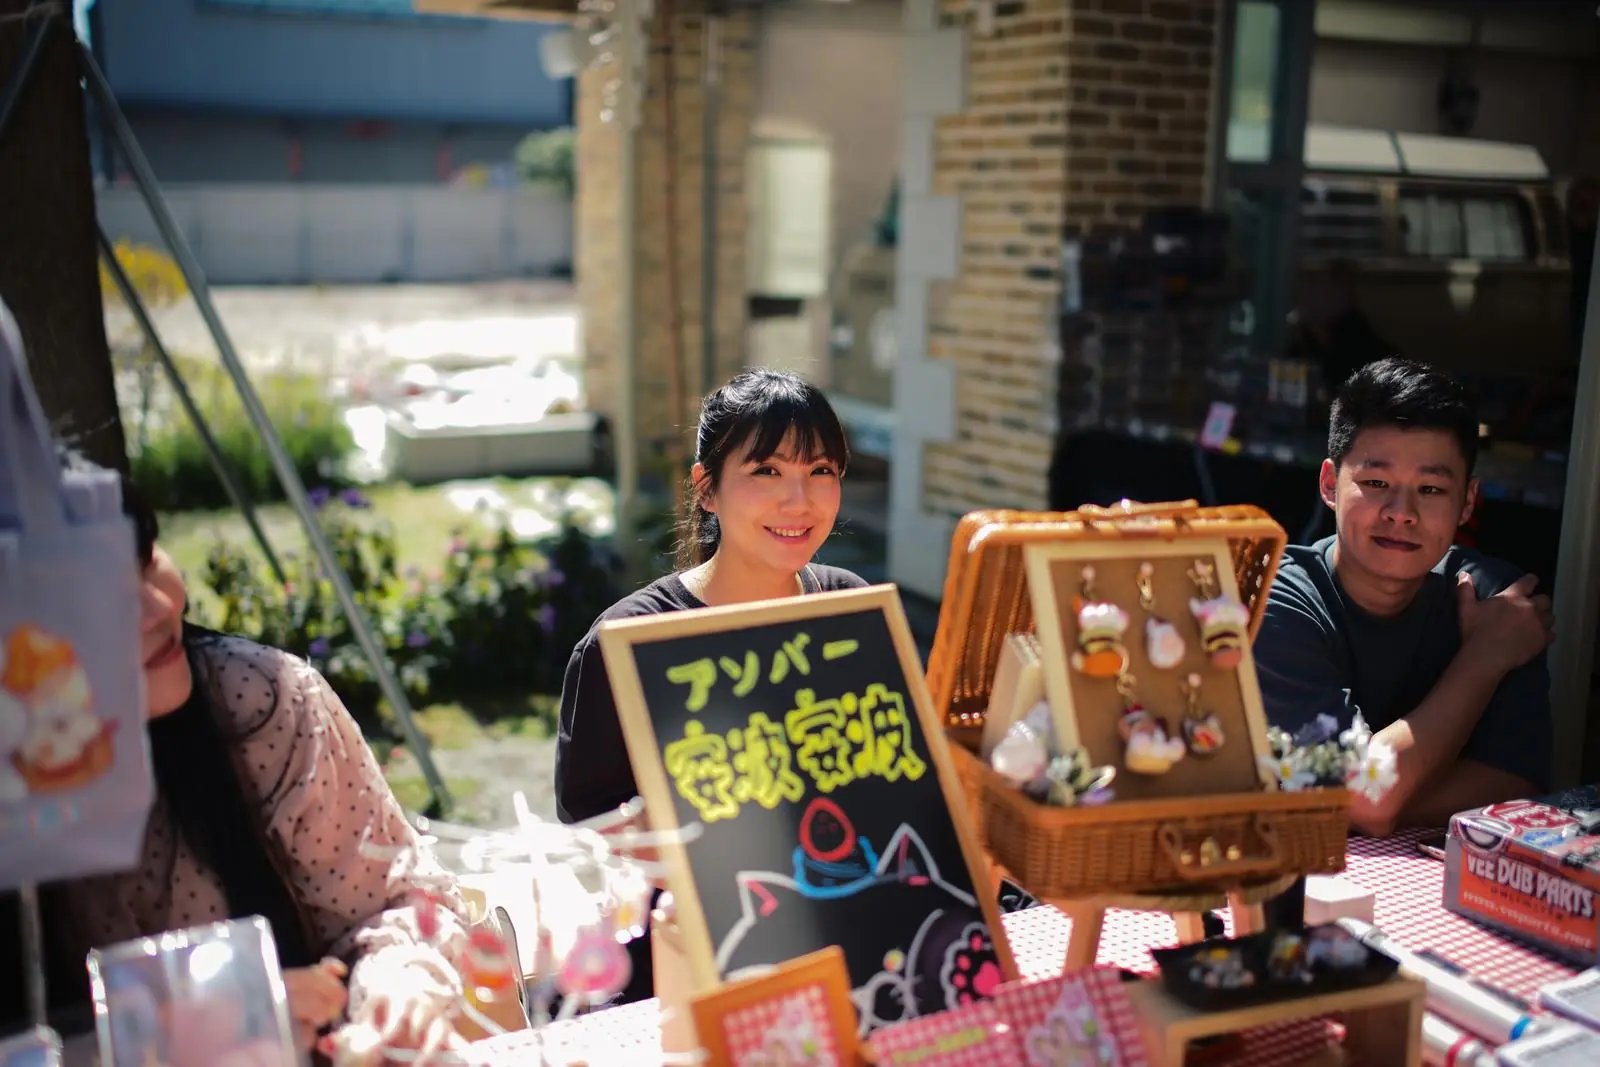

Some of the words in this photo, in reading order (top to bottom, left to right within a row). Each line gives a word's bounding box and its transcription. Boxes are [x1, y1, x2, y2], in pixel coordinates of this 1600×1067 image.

[1467, 854, 1495, 880] VEE
[1497, 857, 1533, 894] DUB
[1536, 871, 1593, 917] PARTS
